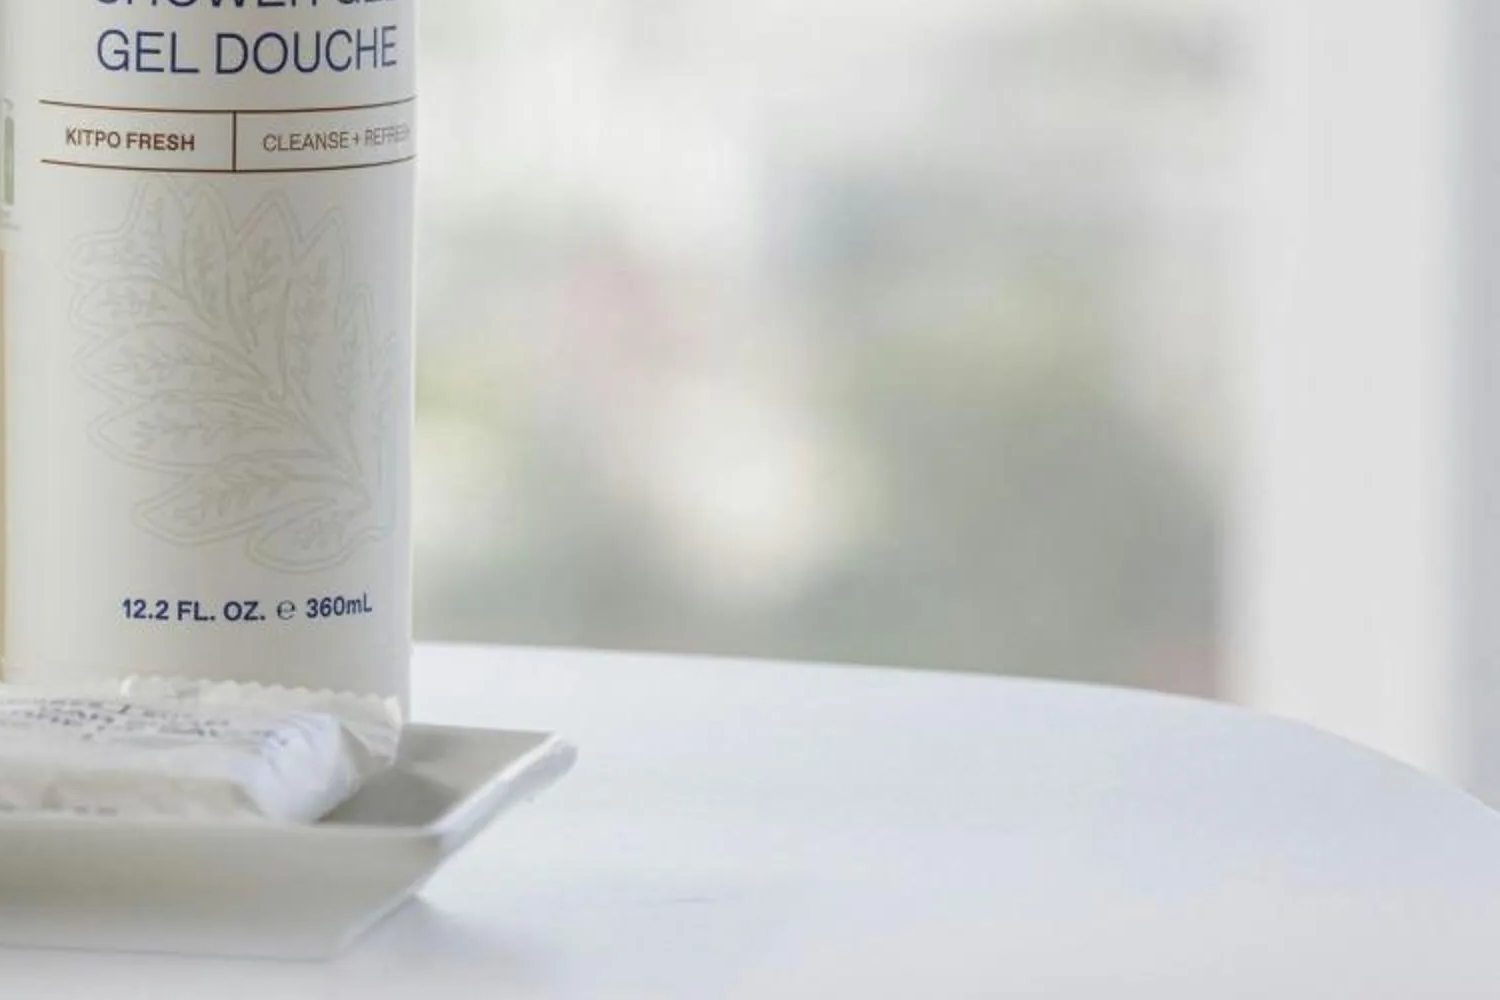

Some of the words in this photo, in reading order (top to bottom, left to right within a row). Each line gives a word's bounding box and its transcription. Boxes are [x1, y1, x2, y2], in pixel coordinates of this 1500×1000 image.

[97, 30, 200, 73] GEL
[216, 25, 397, 74] DOUCHE
[66, 128, 121, 148] KITPO
[126, 132, 194, 151] FRESH
[263, 131, 349, 152] CLEANSE
[123, 598, 169, 620] 12.2
[178, 600, 215, 621] FL.
[224, 601, 265, 621] OZ.
[306, 593, 372, 618] 360mL
